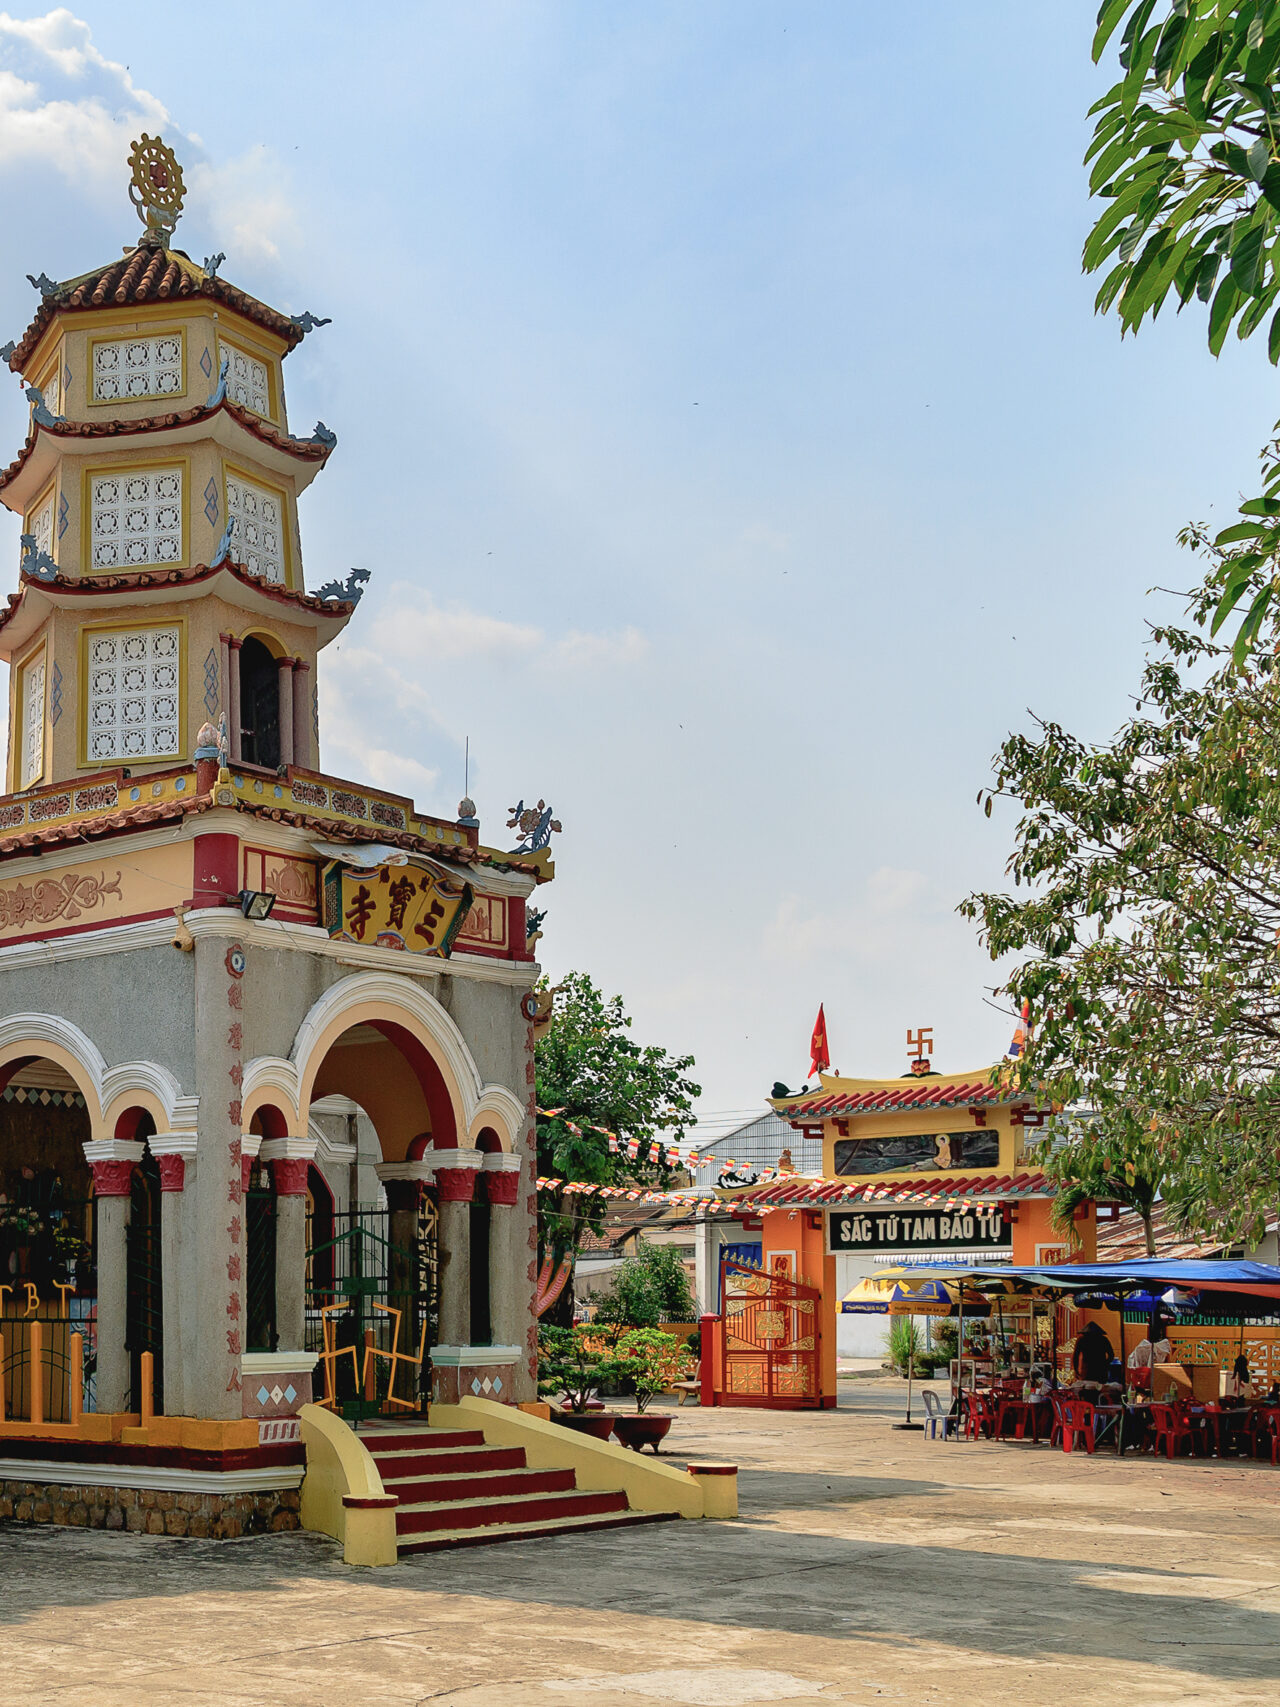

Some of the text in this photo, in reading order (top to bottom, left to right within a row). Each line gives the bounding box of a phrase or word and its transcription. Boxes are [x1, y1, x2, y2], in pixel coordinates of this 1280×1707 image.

[840, 1214, 873, 1242] SẮC
[876, 1214, 900, 1241] TỨ
[902, 1217, 937, 1241] TAM
